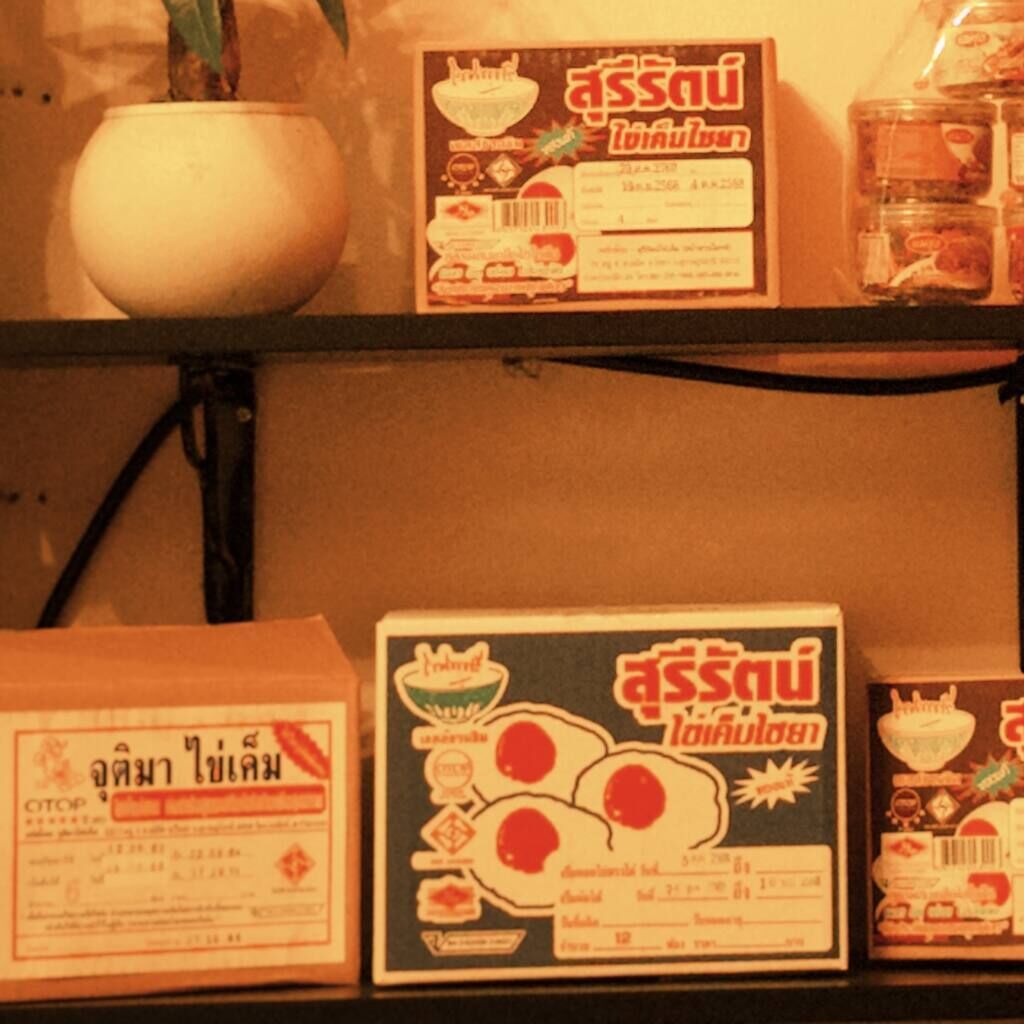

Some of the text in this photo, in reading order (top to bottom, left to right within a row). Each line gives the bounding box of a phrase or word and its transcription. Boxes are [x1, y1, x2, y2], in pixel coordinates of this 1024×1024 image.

[567, 55, 744, 125] สุรีรัตน์
[611, 120, 749, 153] ไข่เค็มไชยา
[622, 641, 817, 721] สุรีรัตน์
[669, 712, 821, 748] ไข่เค็มไชยา
[89, 731, 282, 803] จุติมา ไข่เค็ม
[25, 798, 87, 813] OTOP
[615, 931, 632, 945] 12
